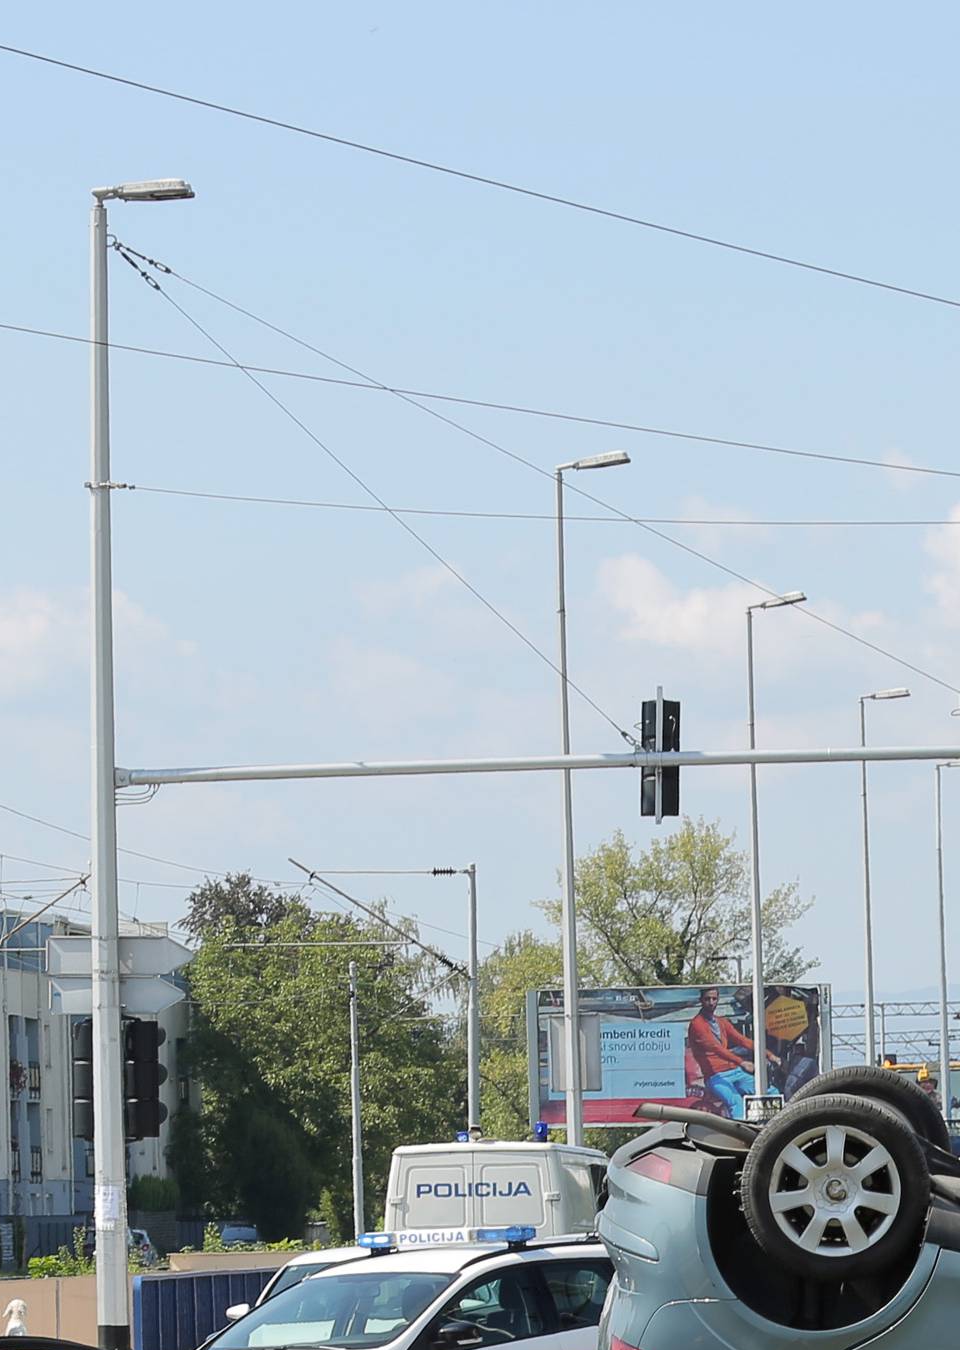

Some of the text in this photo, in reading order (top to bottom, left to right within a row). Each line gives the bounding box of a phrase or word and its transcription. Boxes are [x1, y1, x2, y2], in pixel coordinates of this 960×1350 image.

[600, 1028, 672, 1040] mbeni kredit
[608, 1042, 637, 1052] snovi
[638, 1041, 672, 1054] dobiju
[416, 1181, 533, 1199] POLICIJA
[399, 1231, 465, 1244] POLICIJA
